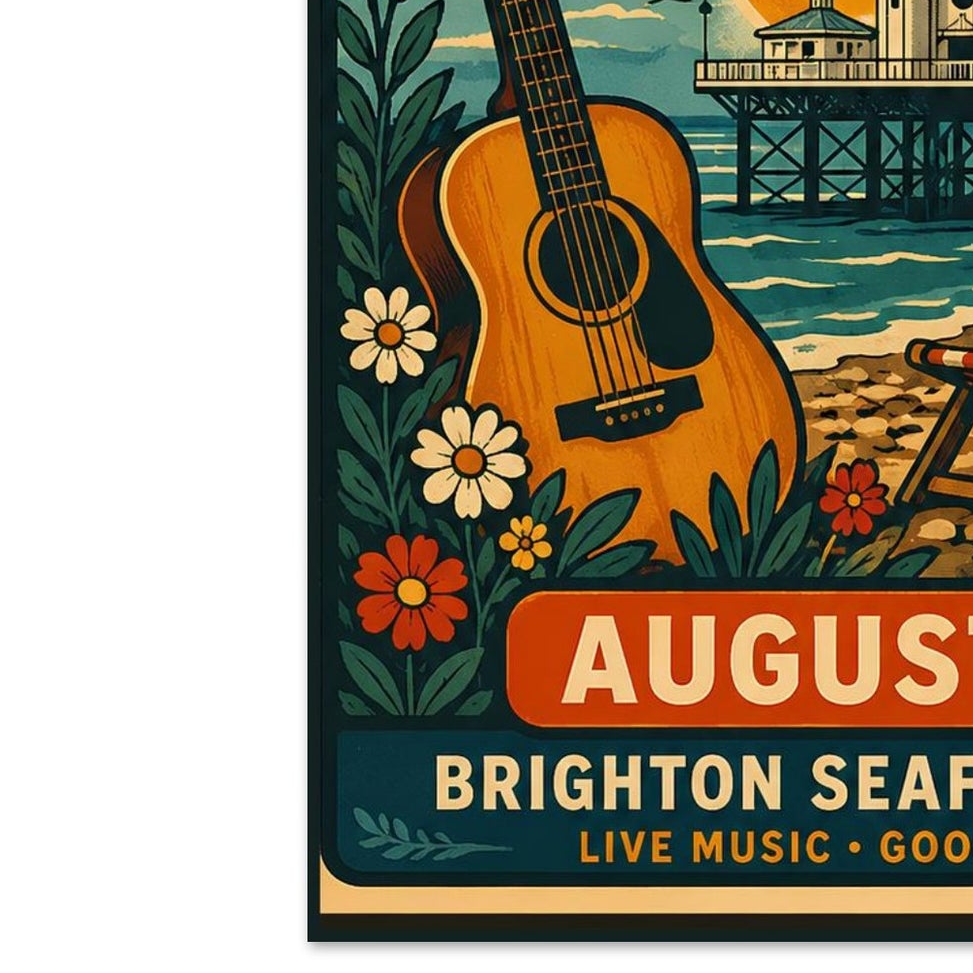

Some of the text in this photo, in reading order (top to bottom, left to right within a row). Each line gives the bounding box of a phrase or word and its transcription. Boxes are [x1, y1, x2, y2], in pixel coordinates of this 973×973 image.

[436, 755, 780, 810] BRIGHTON
[581, 831, 671, 862] LIVE
[694, 831, 829, 862] MUSIC
